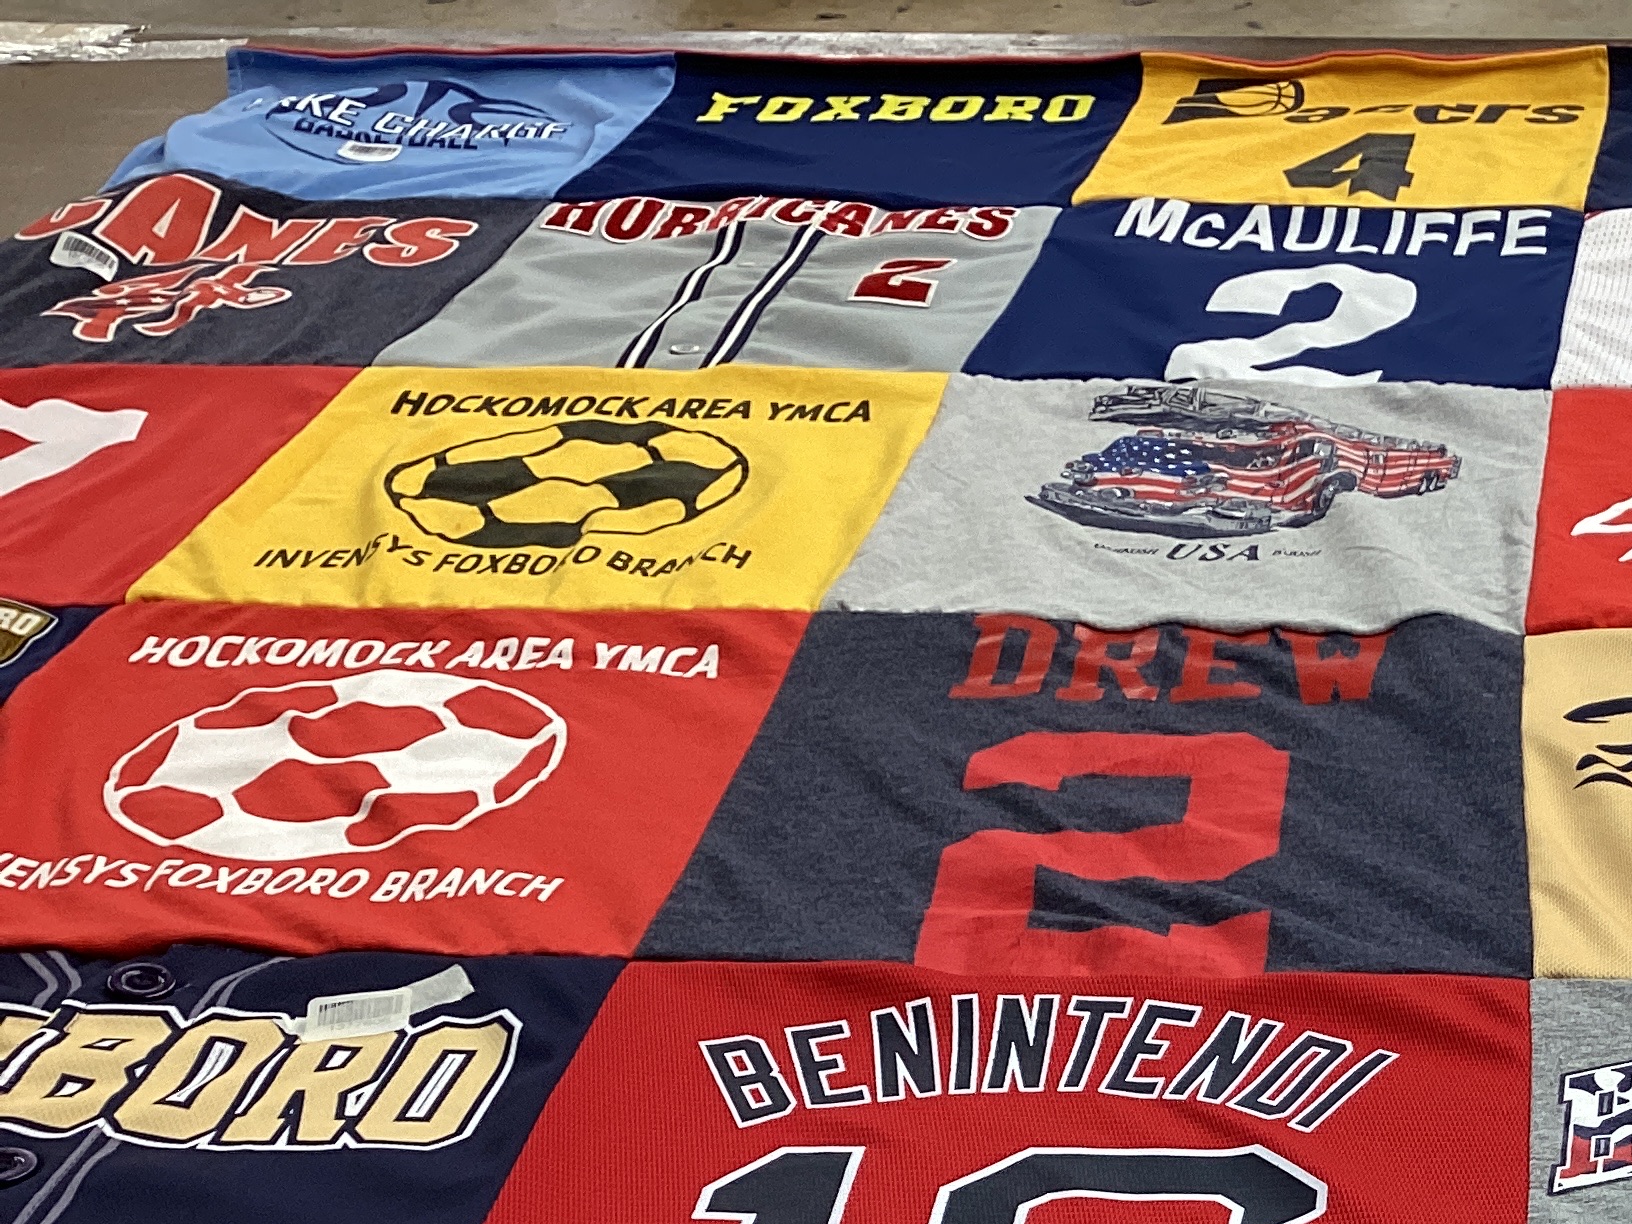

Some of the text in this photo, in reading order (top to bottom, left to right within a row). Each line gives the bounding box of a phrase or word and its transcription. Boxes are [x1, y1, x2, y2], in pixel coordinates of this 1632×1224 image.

[244, 94, 366, 124] KE
[697, 94, 1095, 123] FOXBORO
[1283, 133, 1416, 202] 4
[848, 257, 958, 307] 2
[1163, 264, 1418, 384] 2
[390, 390, 872, 424] HOCKOMOCK AREA YMCA
[1166, 543, 1260, 561] USA
[128, 635, 721, 679] HOCKOMOCK AREA YMCA
[948, 613, 1398, 705] DREW
[914, 732, 1290, 979] 2
[143, 859, 371, 898] FOXBORO
[370, 866, 565, 903] BRANCH
[700, 993, 1400, 1132] BENINTENDI
